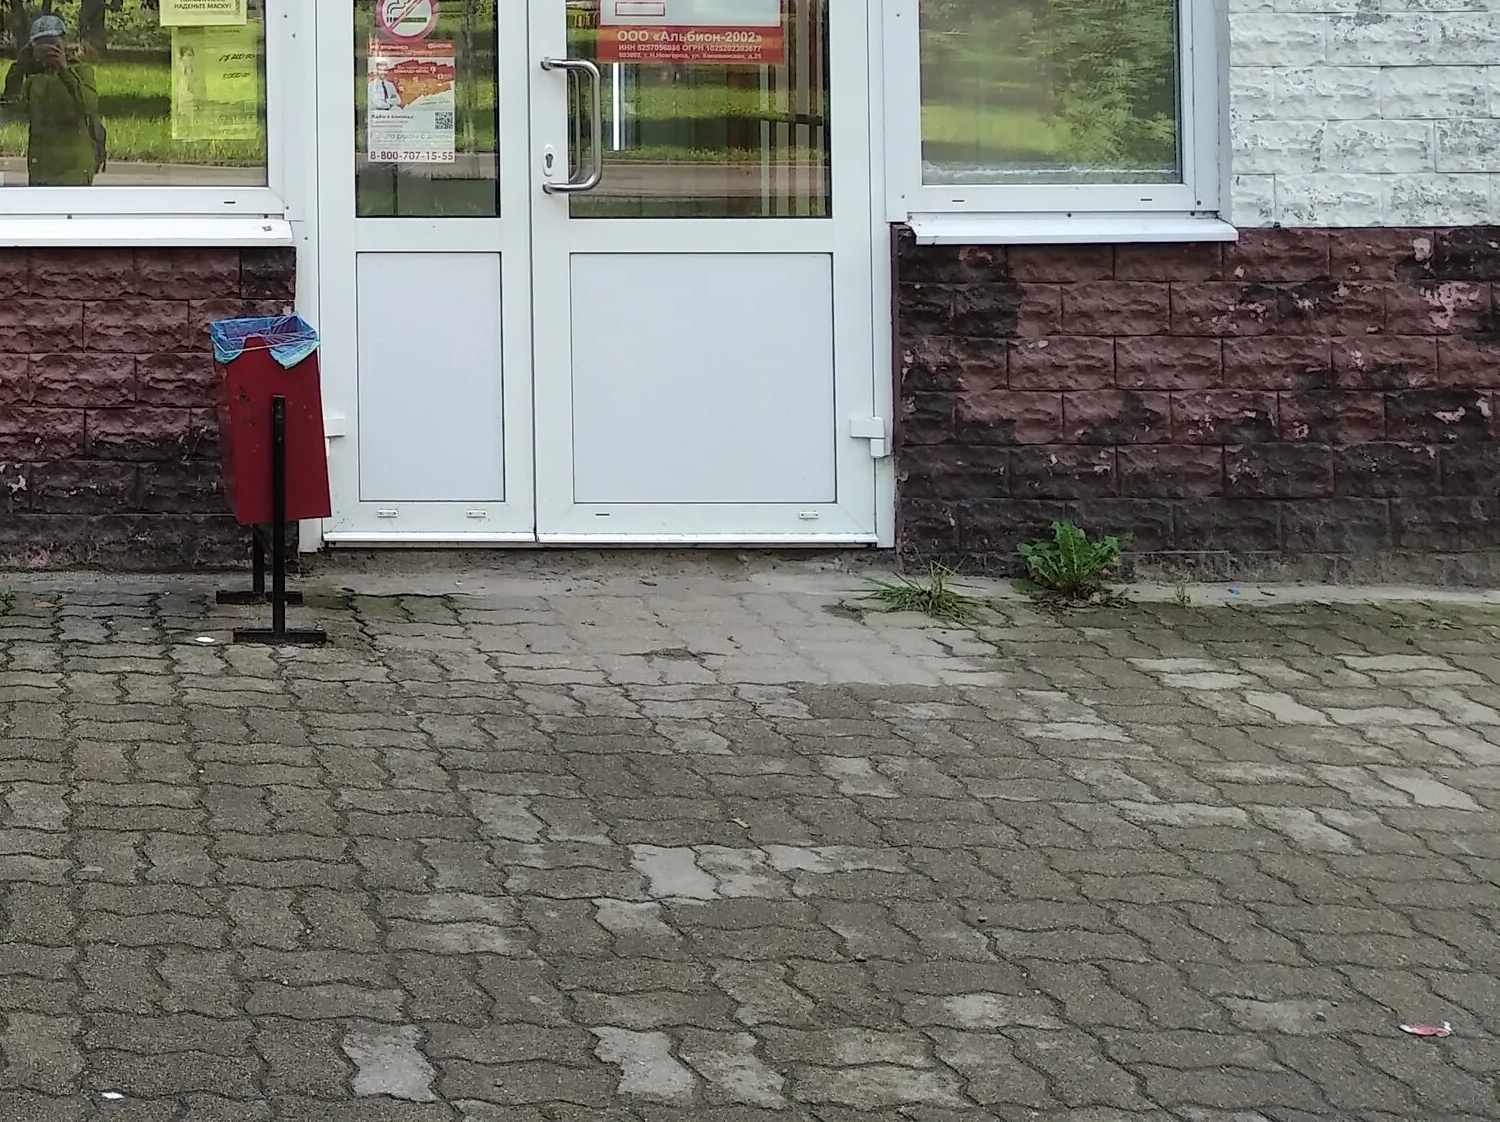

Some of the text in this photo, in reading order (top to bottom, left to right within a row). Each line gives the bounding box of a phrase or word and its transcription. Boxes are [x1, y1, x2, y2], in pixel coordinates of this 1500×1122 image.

[617, 30, 763, 43] ООО «Альбион-2002»
[370, 151, 454, 161] 8-800-707-15-55
